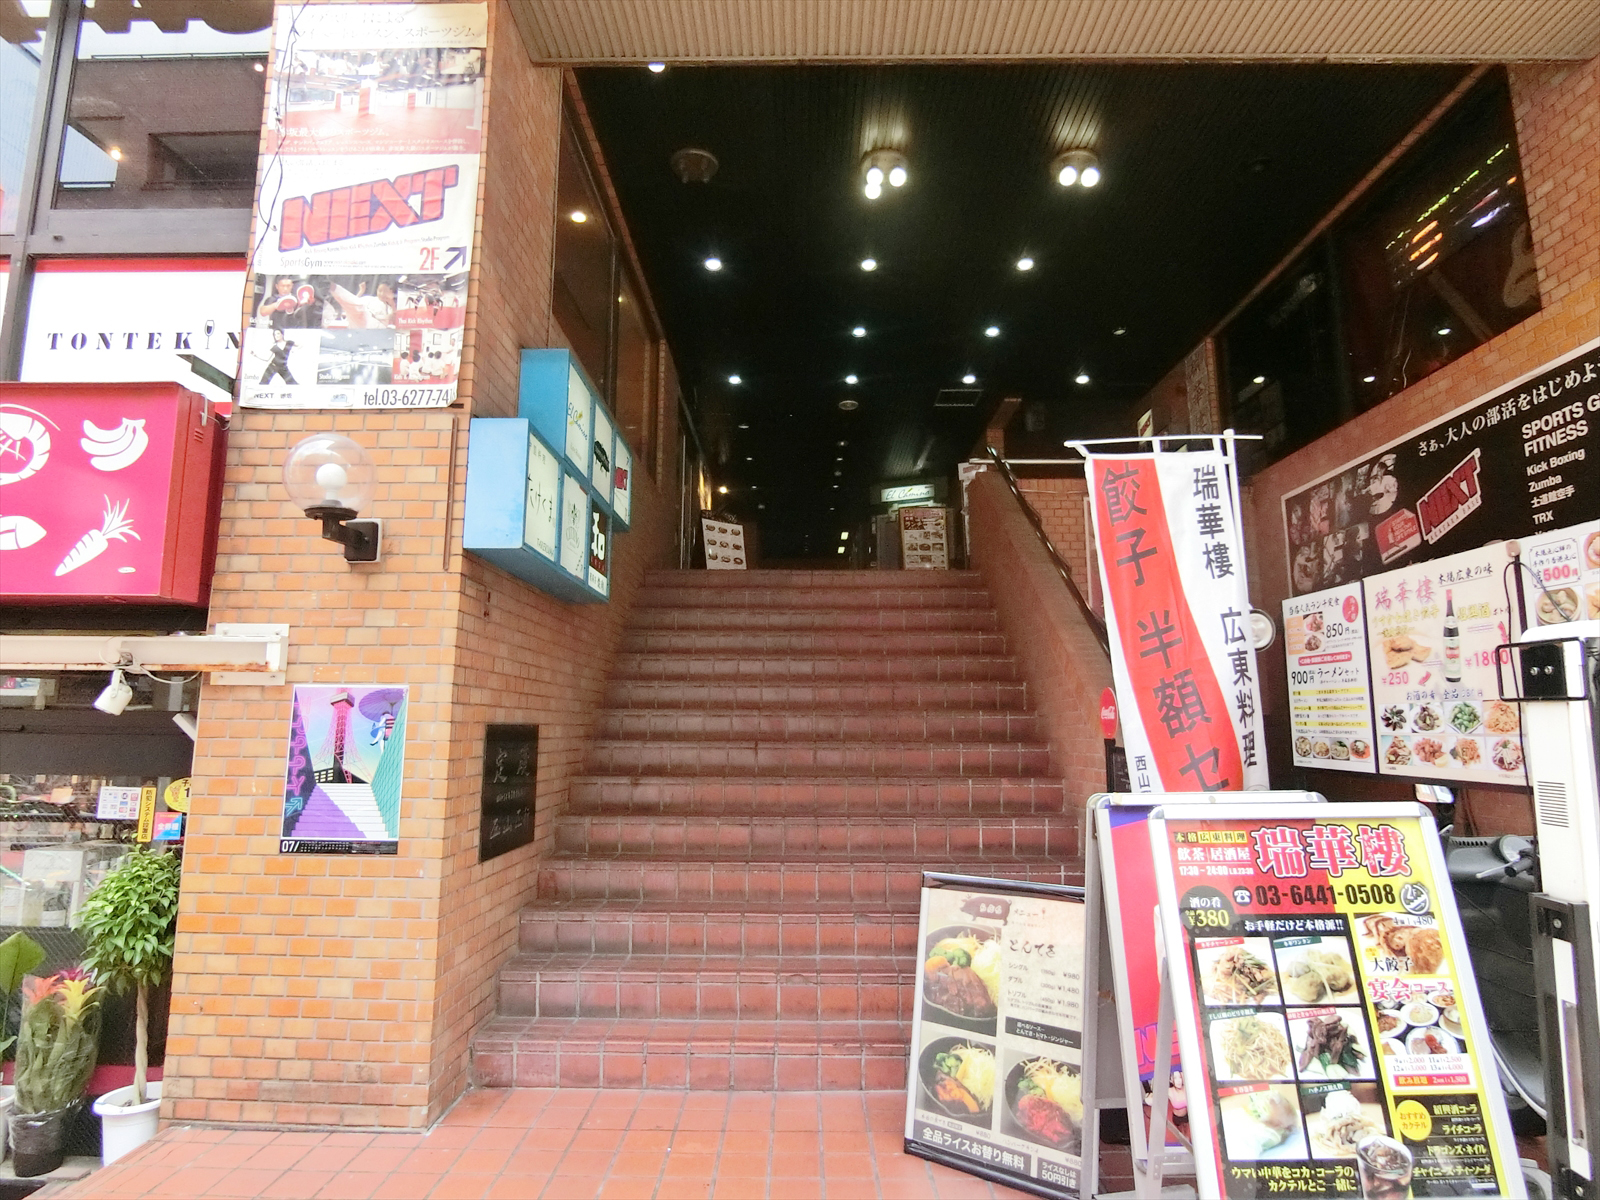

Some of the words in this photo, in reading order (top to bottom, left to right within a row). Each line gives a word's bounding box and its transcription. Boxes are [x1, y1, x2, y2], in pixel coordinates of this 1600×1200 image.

[419, 247, 440, 271] 2F
[1521, 402, 1584, 440] SPORTS
[1523, 419, 1589, 458] FITNESS
[1526, 458, 1549, 477] Kick
[1550, 448, 1586, 470] Boxing
[1528, 474, 1563, 493] Zumba
[1532, 510, 1555, 525] TRX
[1219, 606, 1258, 768] 広東料理
[1134, 754, 1152, 793] 西山
[1174, 830, 1248, 844] 本格広東料理
[1177, 847, 1206, 862] 飲茶
[1210, 846, 1251, 861] 居酒屋
[1189, 896, 1222, 909] 酒の肴
[1255, 883, 1396, 907] 03-6441-0508
[1008, 938, 1057, 959] とんてき
[1062, 971, 1081, 981] ¥980
[1367, 978, 1449, 1002] 宴会コース
[1399, 1112, 1426, 1120] おすすめ
[1402, 1121, 1427, 1130] カクテル
[1442, 1123, 1483, 1136] ライチコーラ
[922, 1126, 1025, 1171] 全品ライスお替り無料
[1041, 1161, 1077, 1179] ライスなしは
[1041, 1169, 1077, 1189] 50円引き
[1230, 1165, 1355, 1181] ウマい中華をコカ・コーラの
[1267, 1178, 1358, 1192] カクテルとご一緒に
